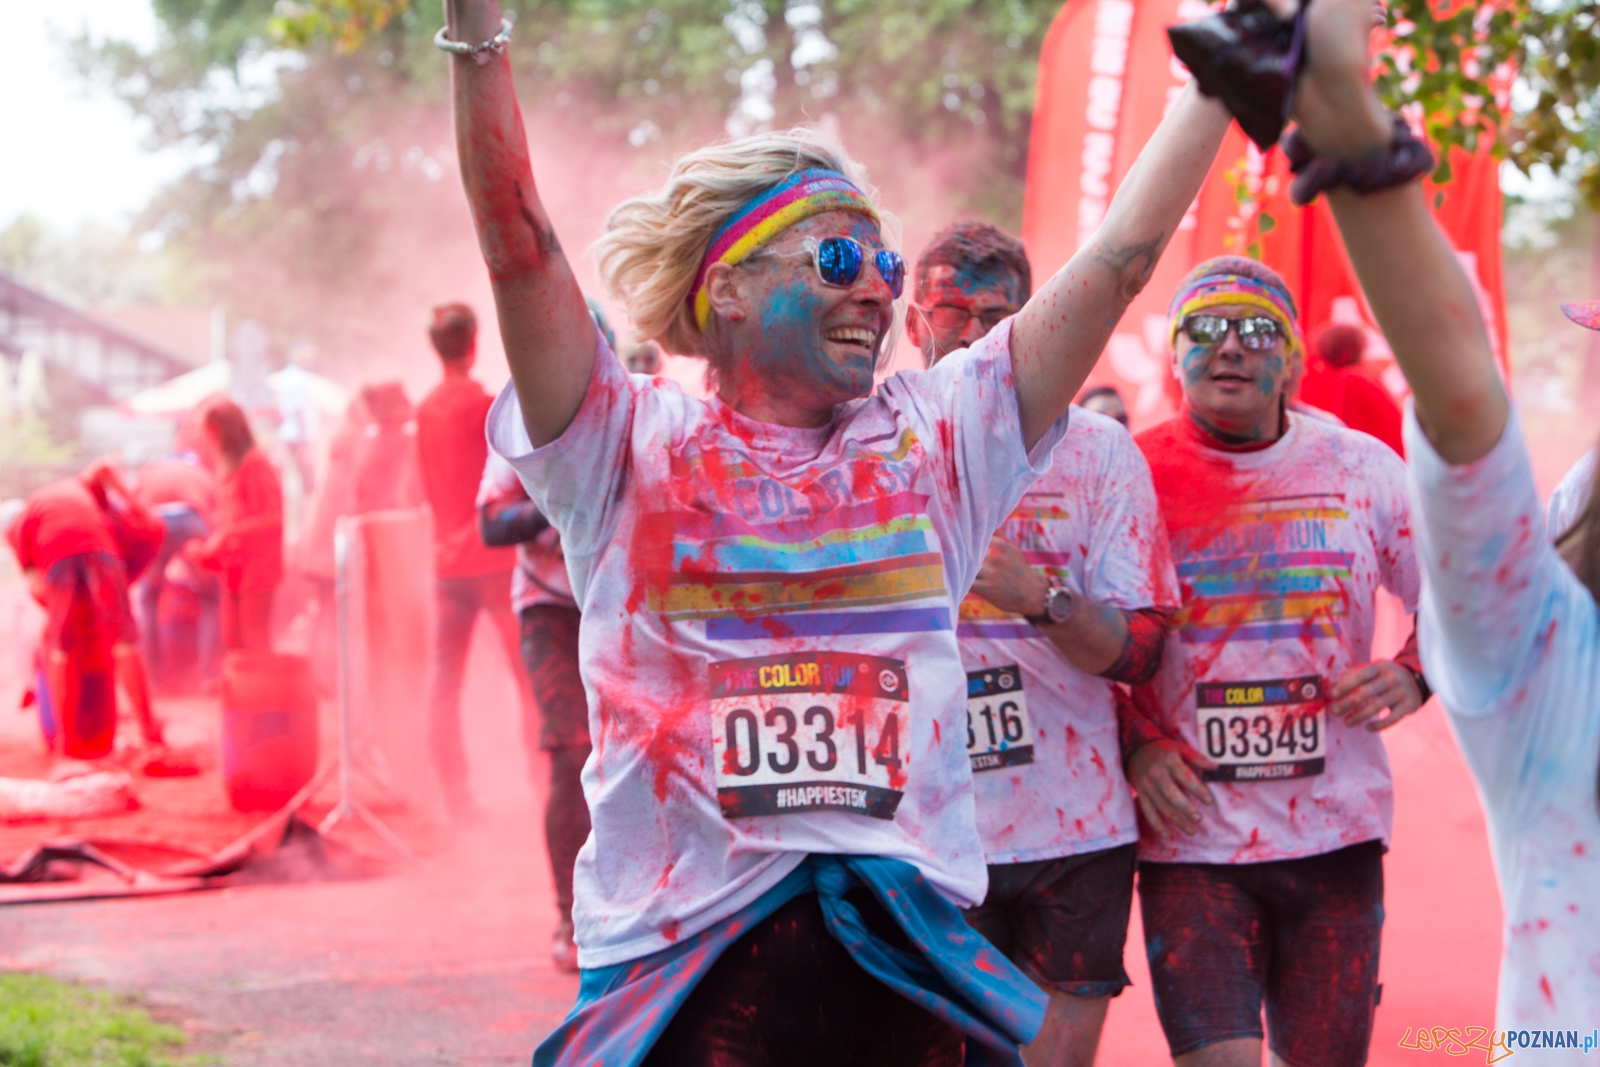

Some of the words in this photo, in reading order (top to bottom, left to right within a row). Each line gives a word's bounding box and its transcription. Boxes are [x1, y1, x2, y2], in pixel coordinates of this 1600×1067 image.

[1282, 519, 1326, 550] RUN
[723, 667, 757, 692] THE
[759, 662, 821, 689] COLOR
[823, 663, 856, 687] RUN
[1204, 688, 1225, 705] THE
[1225, 686, 1265, 706] COLOR
[725, 705, 902, 777] 03314
[1206, 713, 1319, 758] 03349
[776, 786, 867, 809] #HAPPIEST5K
